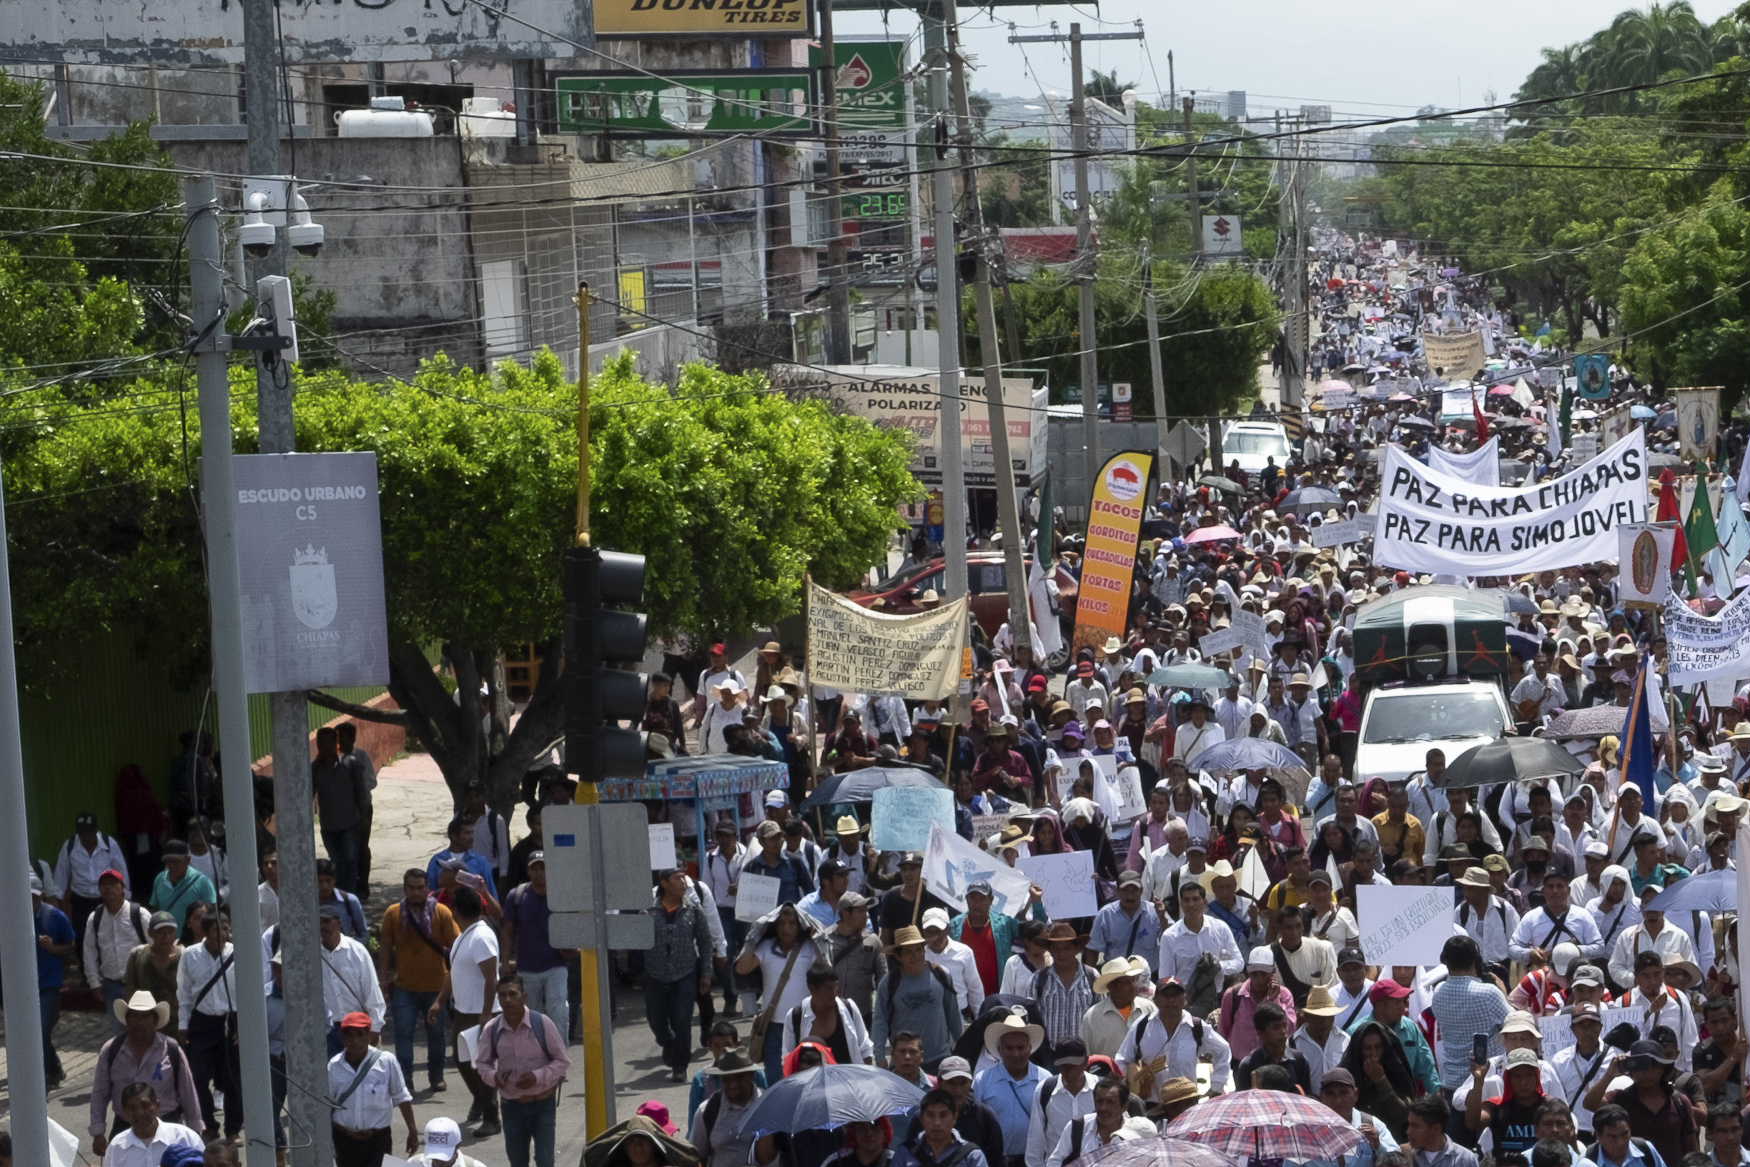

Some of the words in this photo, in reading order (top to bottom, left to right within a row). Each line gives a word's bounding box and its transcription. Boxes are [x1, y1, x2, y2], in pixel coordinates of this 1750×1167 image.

[724, 11, 801, 23] TIRES
[868, 399, 966, 412] POLARIZAO
[1390, 466, 1442, 509] PAZ
[1452, 493, 1532, 518] PARA
[1539, 448, 1641, 510] CHIAPAS
[238, 488, 301, 503] ESCUDO
[305, 485, 366, 500] URBANO
[295, 505, 317, 520] C5
[1094, 500, 1140, 519] TACOS
[1090, 525, 1136, 543] GORDITAS
[1384, 512, 1431, 544] PAZ
[1438, 523, 1501, 552] PARA
[1085, 548, 1133, 568] QUESADILLAS
[1083, 574, 1121, 592] TORTAS
[1079, 597, 1108, 613] KILOS
[810, 607, 853, 622] EXIGIMOS
[297, 631, 340, 643] CHIAPAS
[833, 622, 845, 631] DE
[850, 623, 867, 634] LOS
[816, 629, 852, 643] MANUEL
[897, 640, 920, 650] CRUZ
[817, 650, 856, 665] AGUSTIN
[862, 657, 893, 669] PEREZ
[847, 645, 886, 658] VELASCO
[816, 661, 850, 674] MARTIN
[855, 667, 883, 679] PEREZ
[1363, 933, 1379, 950] PAZ
